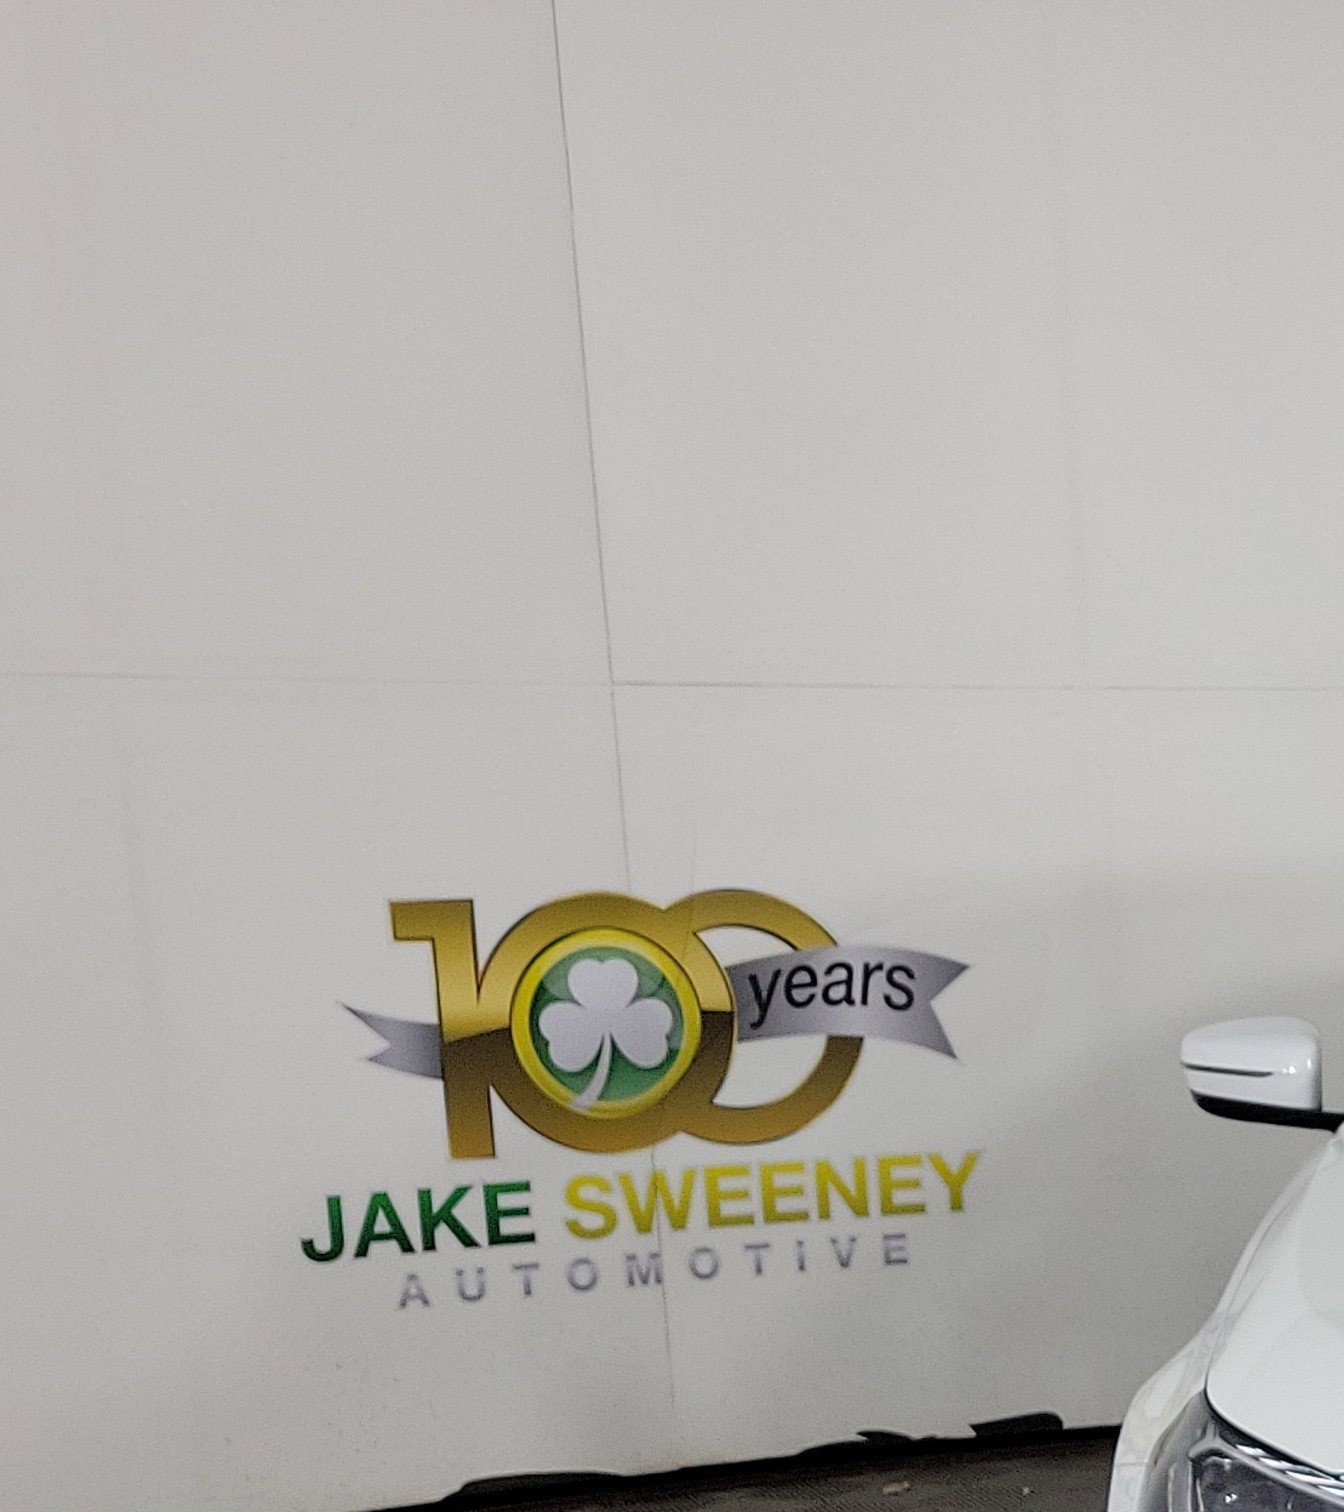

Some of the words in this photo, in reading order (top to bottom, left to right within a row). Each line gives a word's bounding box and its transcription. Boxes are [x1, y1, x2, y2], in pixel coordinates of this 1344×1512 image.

[388, 889, 865, 1160] 100
[747, 961, 916, 1030] years
[300, 1180, 536, 1263] JAKE
[562, 1149, 982, 1241] SWEENEY
[397, 1233, 910, 1310] AUTOMOTIVE
